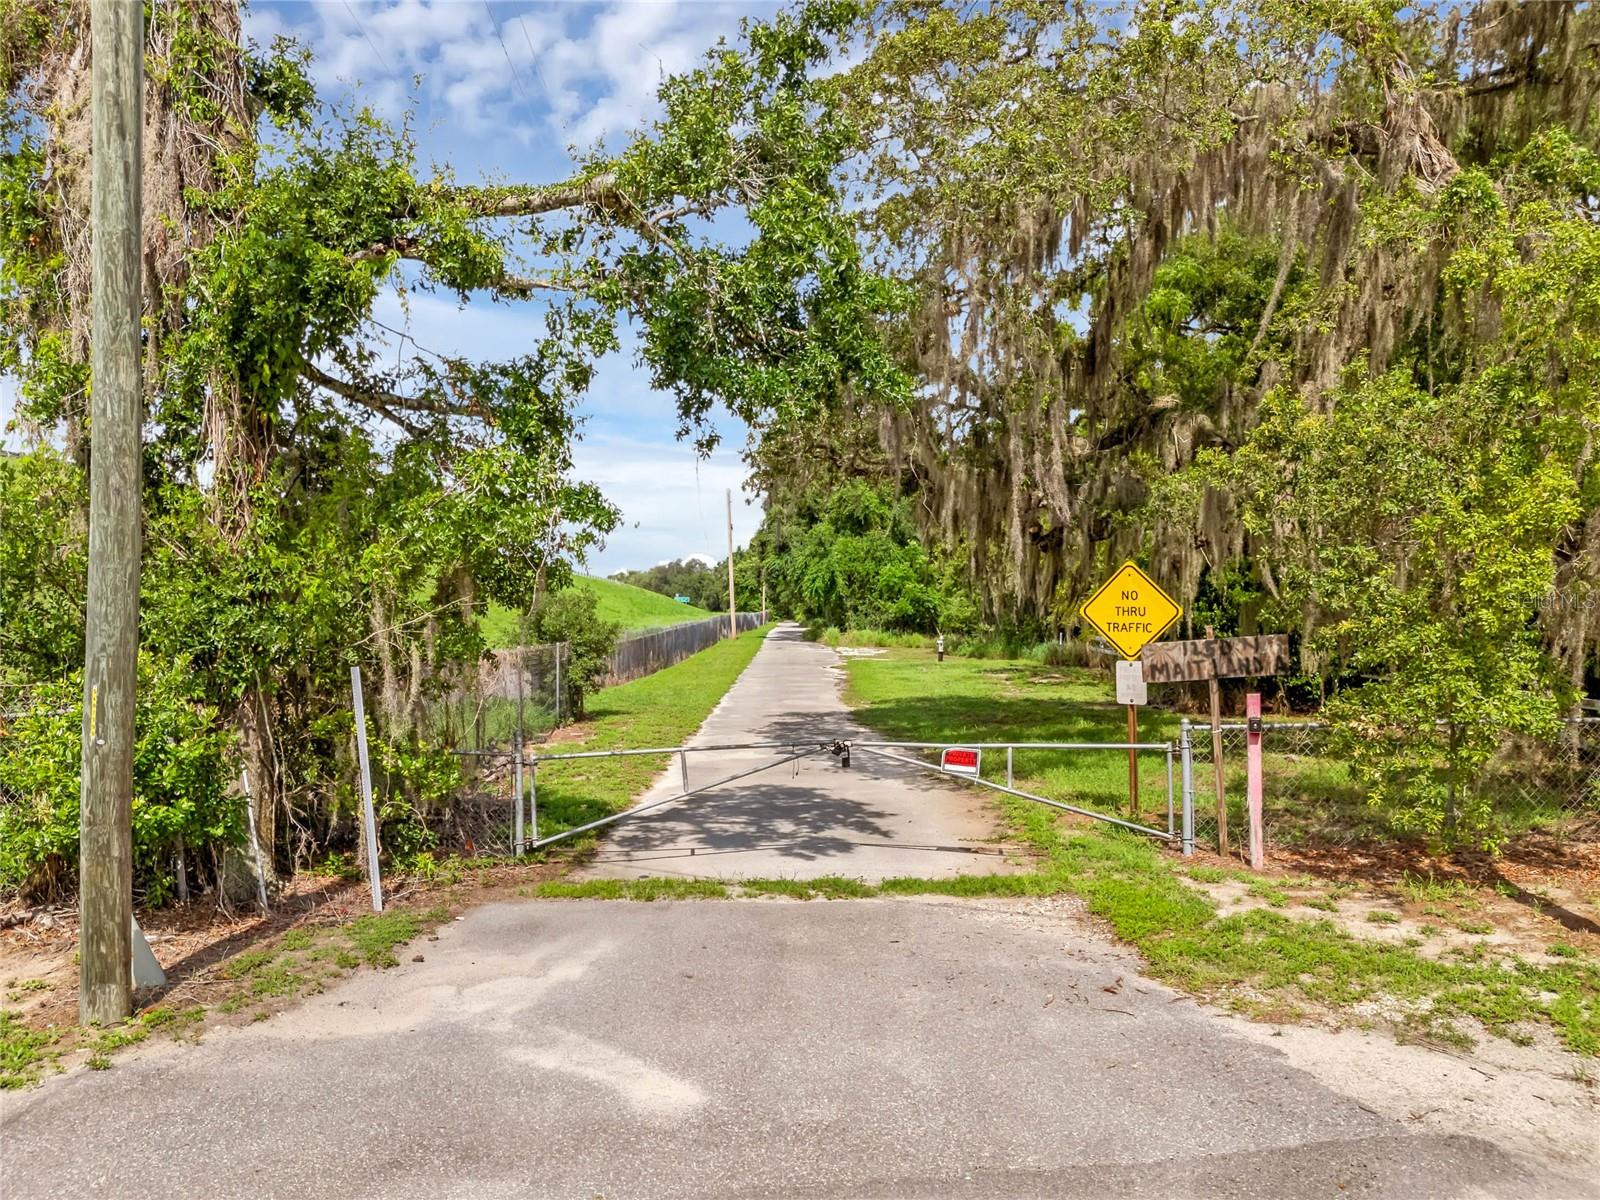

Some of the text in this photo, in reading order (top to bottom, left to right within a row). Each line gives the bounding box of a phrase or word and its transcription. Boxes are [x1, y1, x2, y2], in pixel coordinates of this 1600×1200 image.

[1121, 590, 1139, 601] NO
[1115, 606, 1146, 617] THRU
[1106, 622, 1153, 633] TRAFFIC
[1150, 655, 1264, 681] MAITLAND
